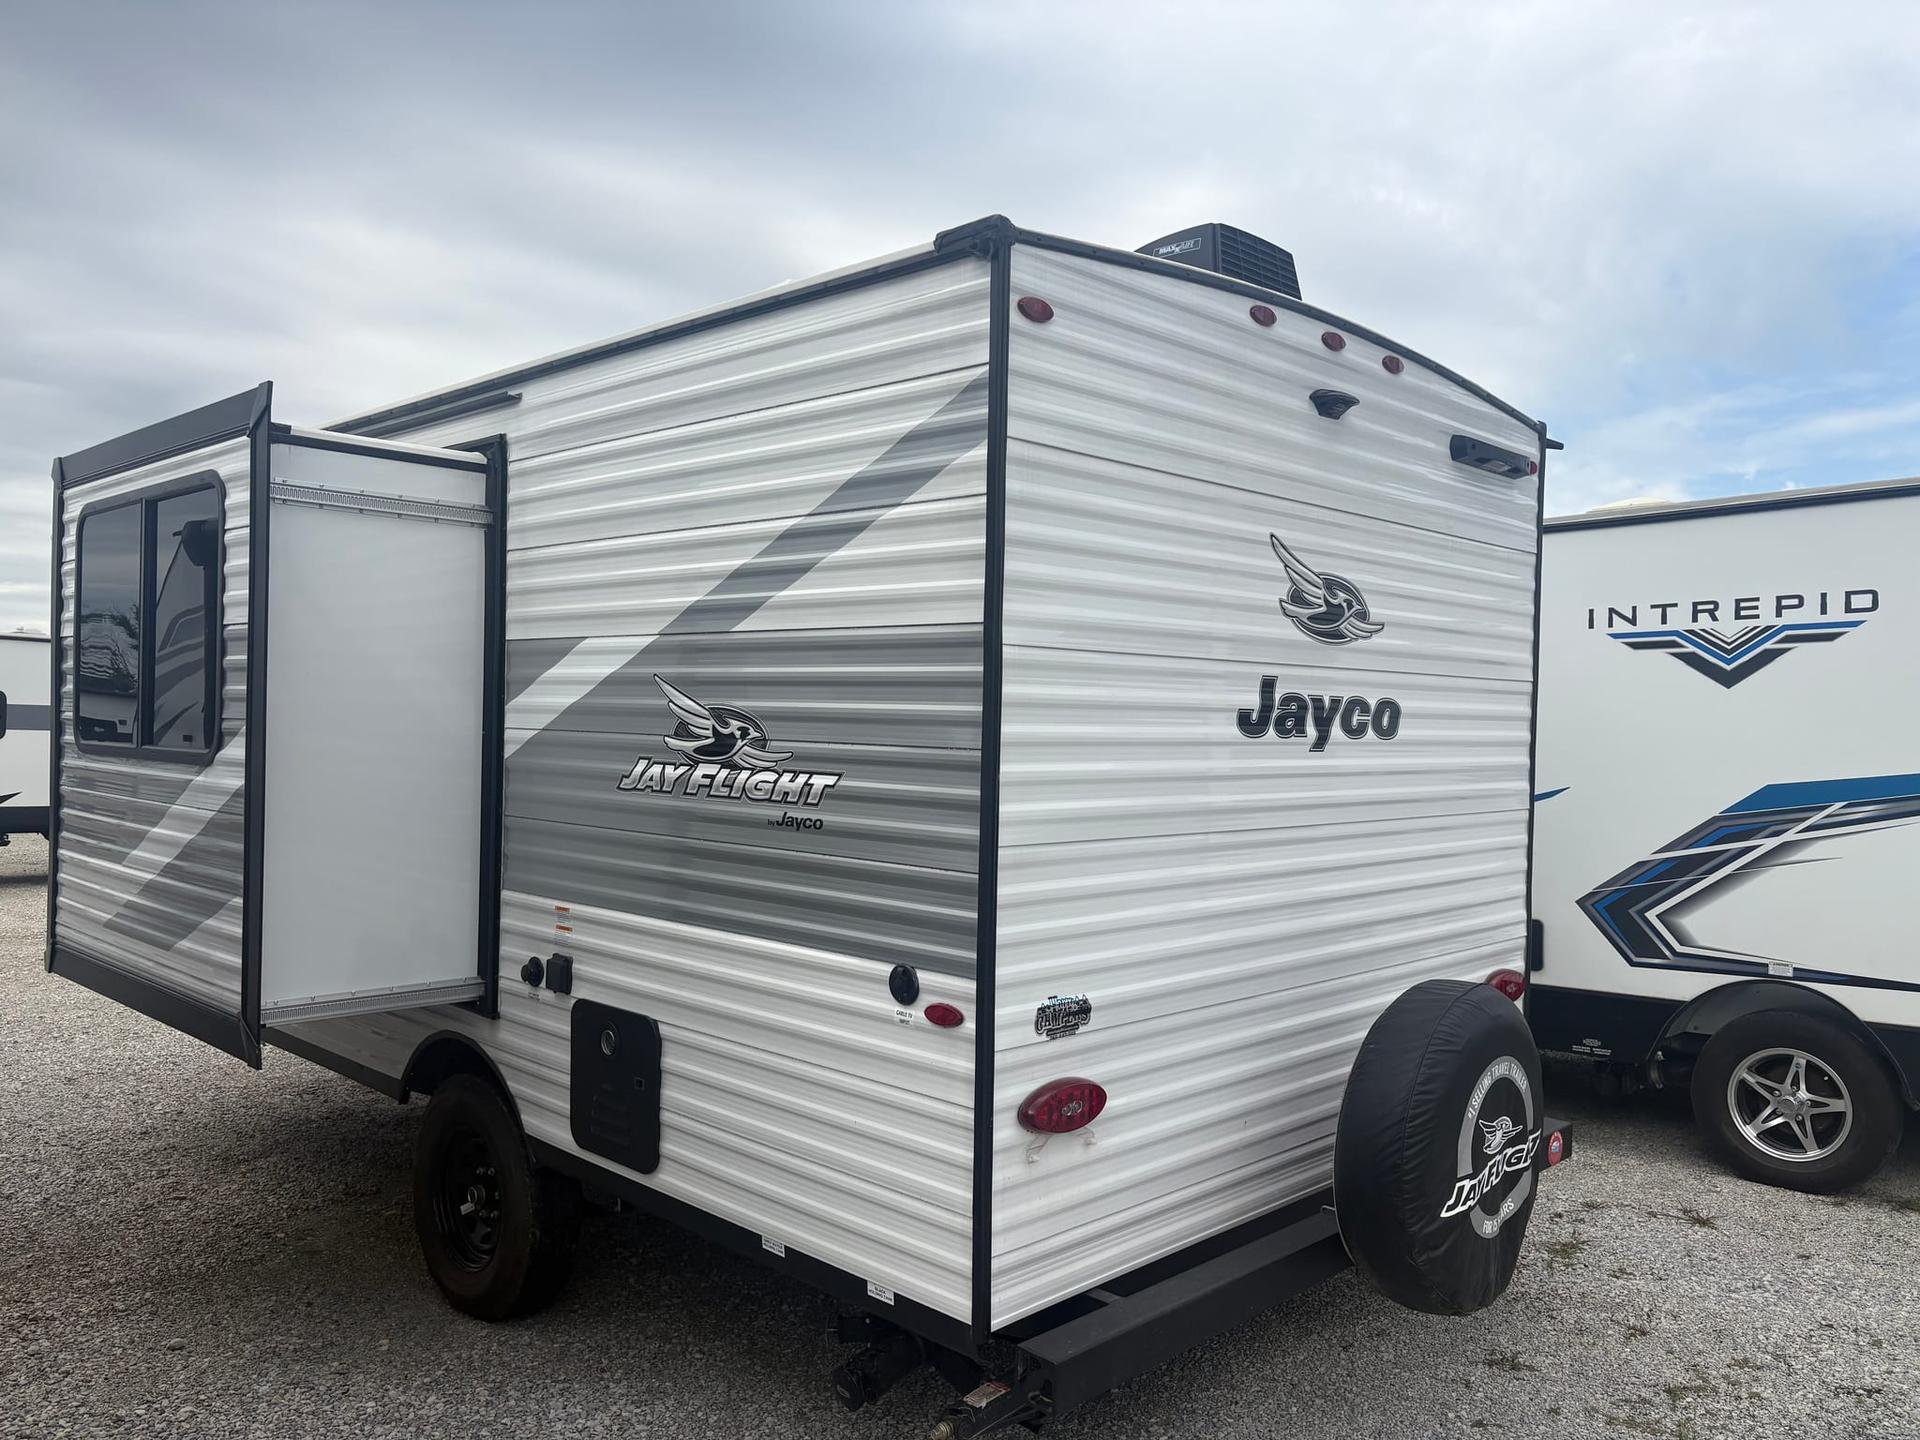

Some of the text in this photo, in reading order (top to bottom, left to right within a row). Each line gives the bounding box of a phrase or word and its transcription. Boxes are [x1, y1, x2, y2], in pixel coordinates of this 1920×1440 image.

[1587, 588, 1880, 631] INTREPID
[1236, 674, 1403, 753] Jayco
[617, 756, 844, 808] JAY FLIGHT
[776, 811, 824, 831] Jayco
[1472, 1072, 1491, 1109] SELLING
[1491, 1062, 1509, 1079] TRAVEL
